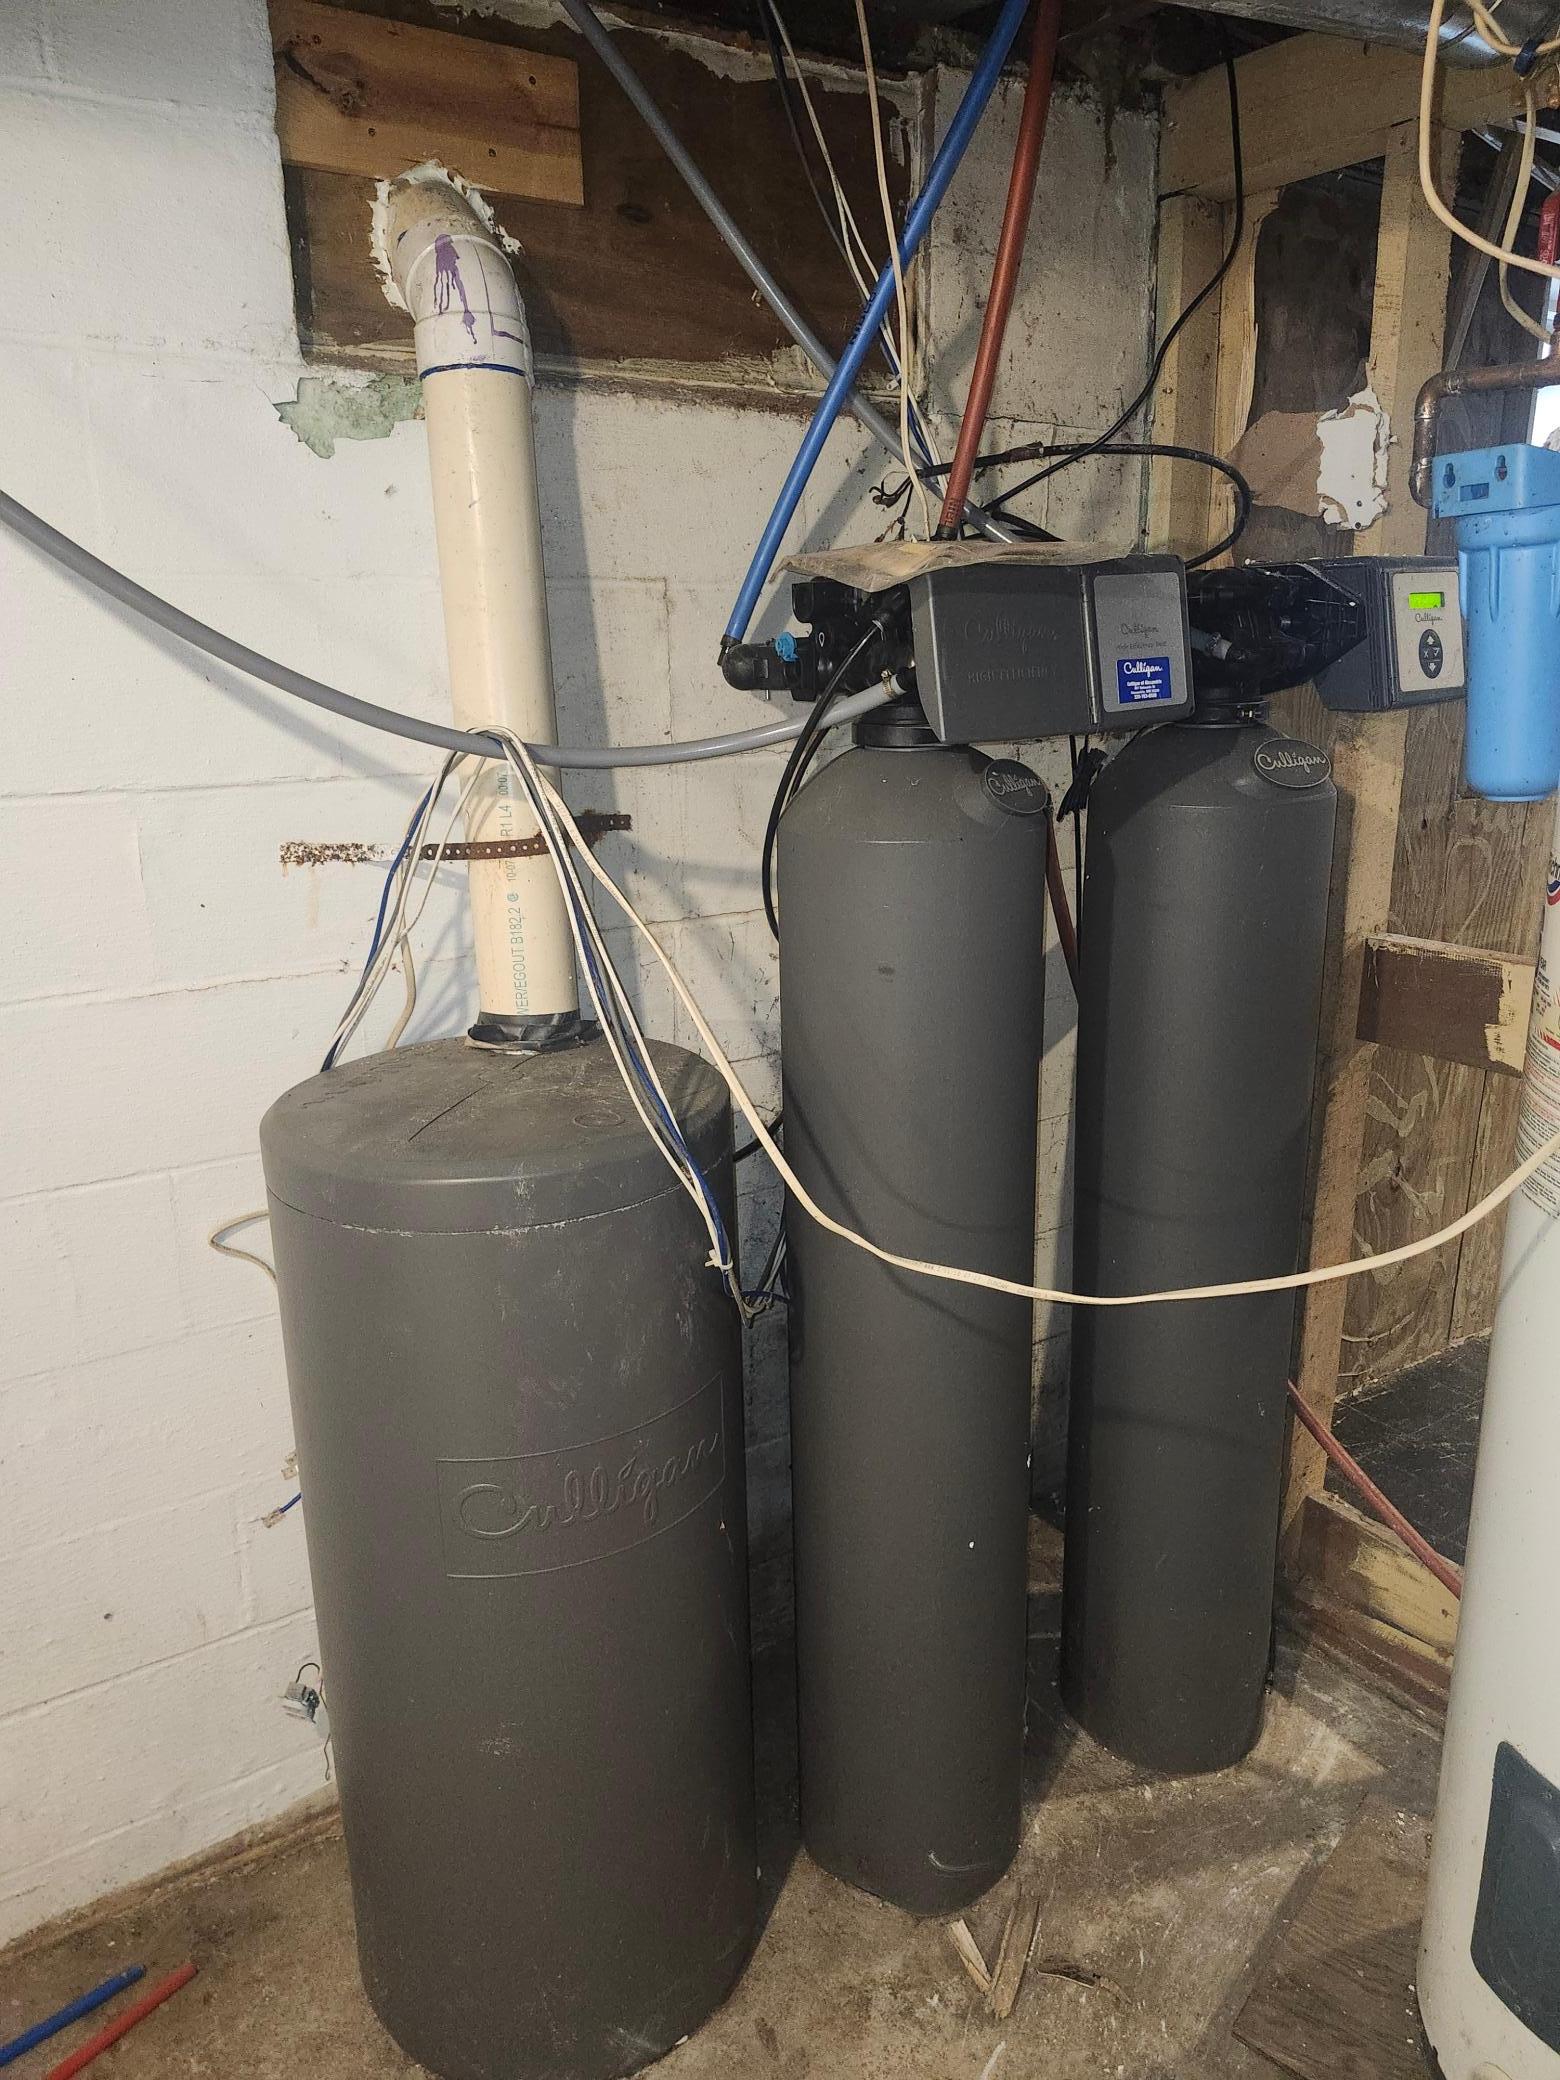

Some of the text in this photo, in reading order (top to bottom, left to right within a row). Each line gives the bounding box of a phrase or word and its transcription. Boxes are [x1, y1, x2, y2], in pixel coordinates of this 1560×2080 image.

[1415, 612, 1443, 626] Culligan
[1123, 661, 1163, 678] Culligan
[1256, 752, 1326, 776] Culligan
[987, 771, 1043, 797] Culligan
[508, 907, 524, 944] B182.2
[460, 1432, 719, 1538] Culligan
